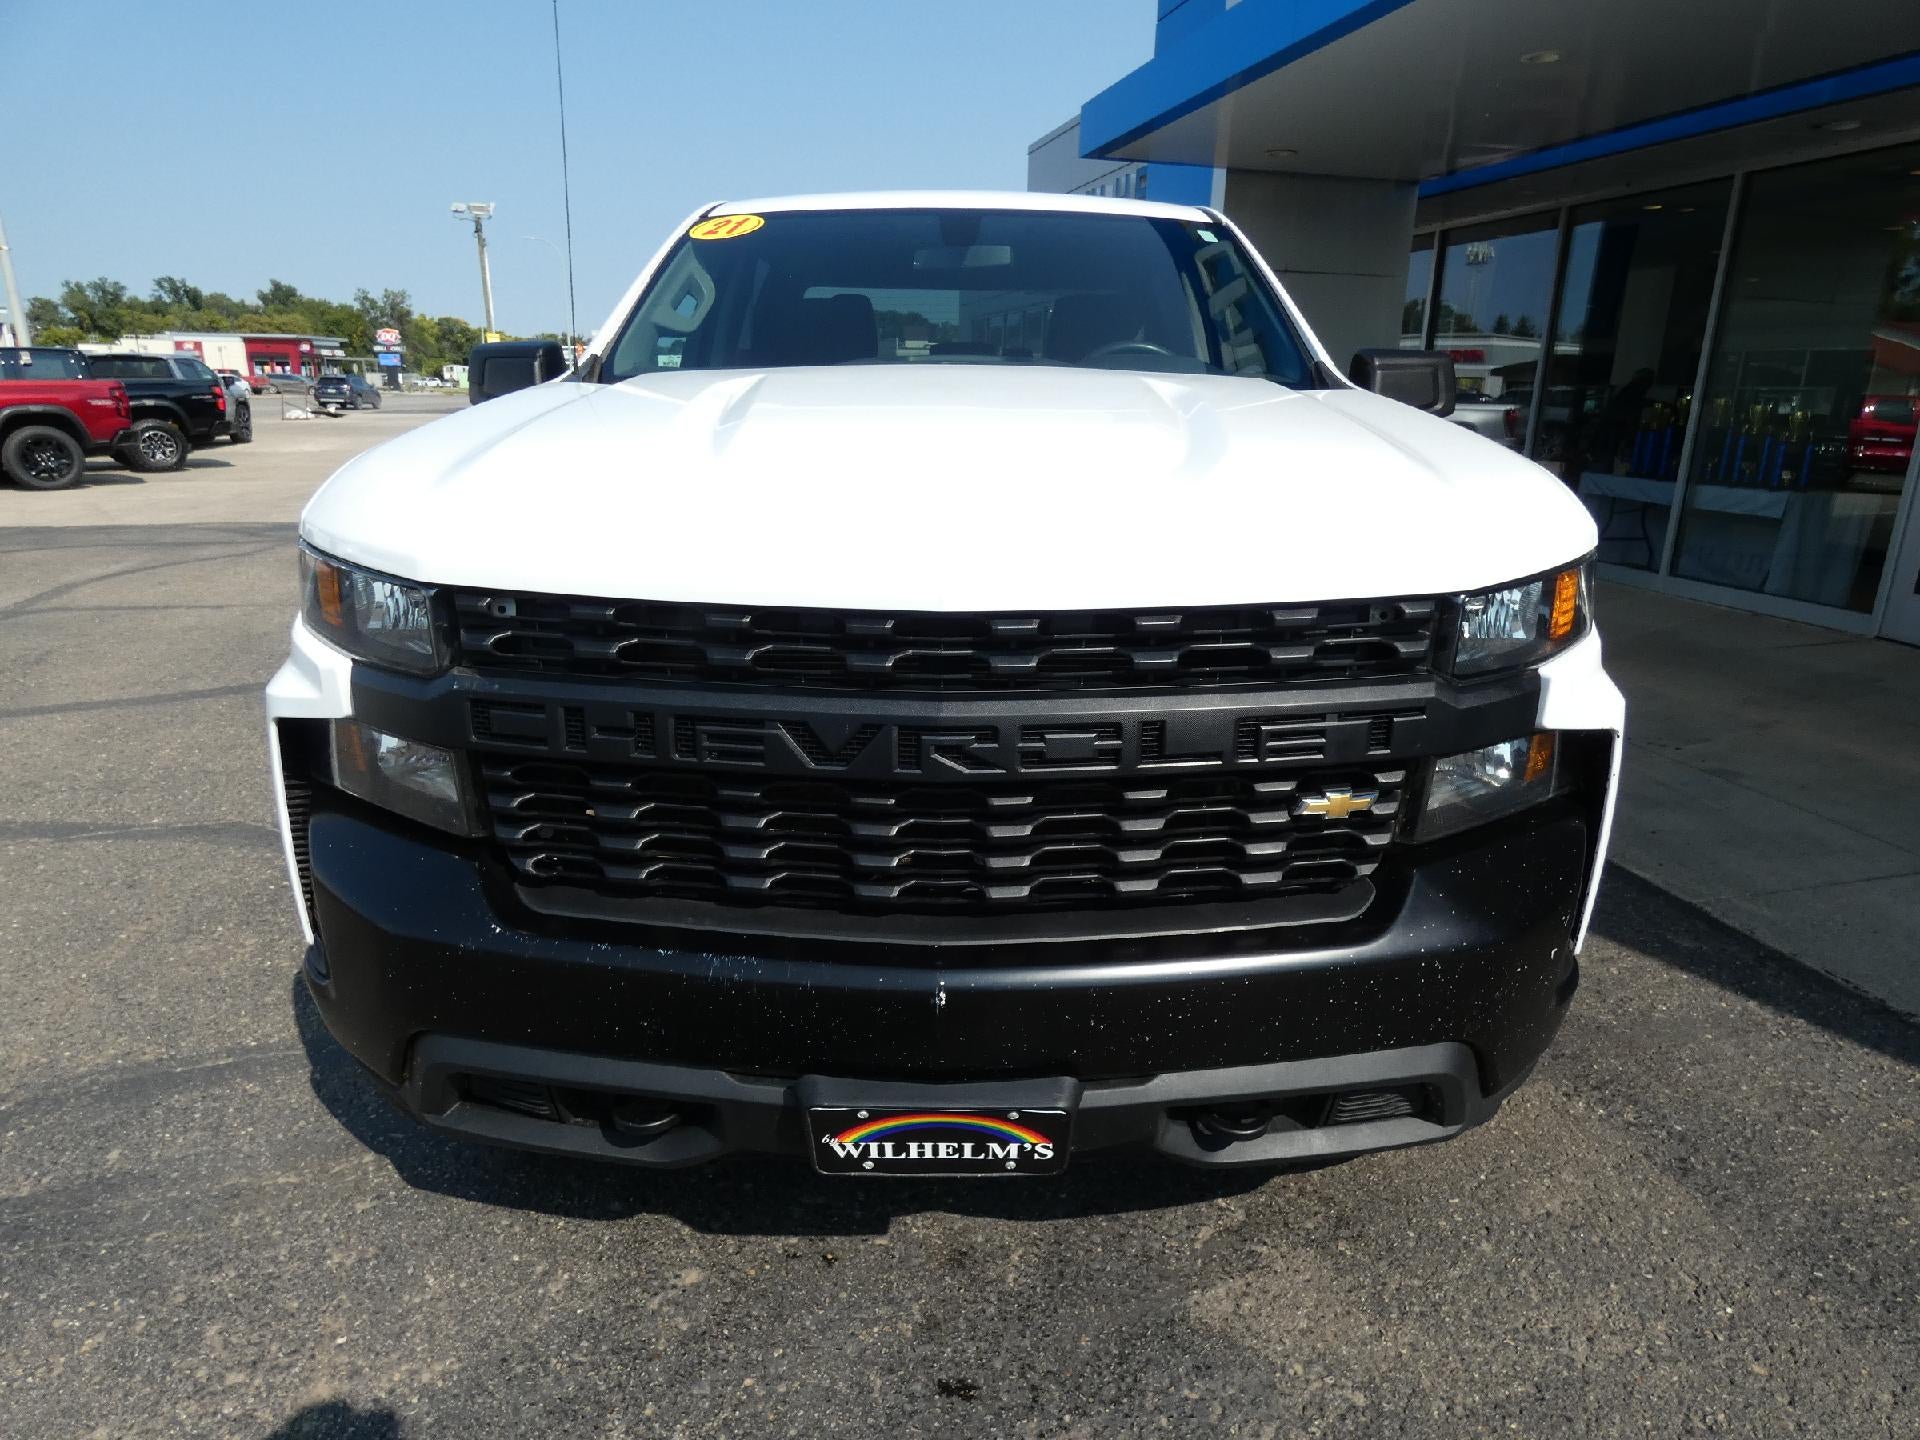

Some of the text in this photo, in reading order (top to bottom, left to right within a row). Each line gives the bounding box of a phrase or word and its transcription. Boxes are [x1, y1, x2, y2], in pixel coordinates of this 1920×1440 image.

[702, 217, 751, 236] 21
[470, 701, 1427, 774] CHEVROLET
[832, 1141, 1055, 1160] WILHELM'S
